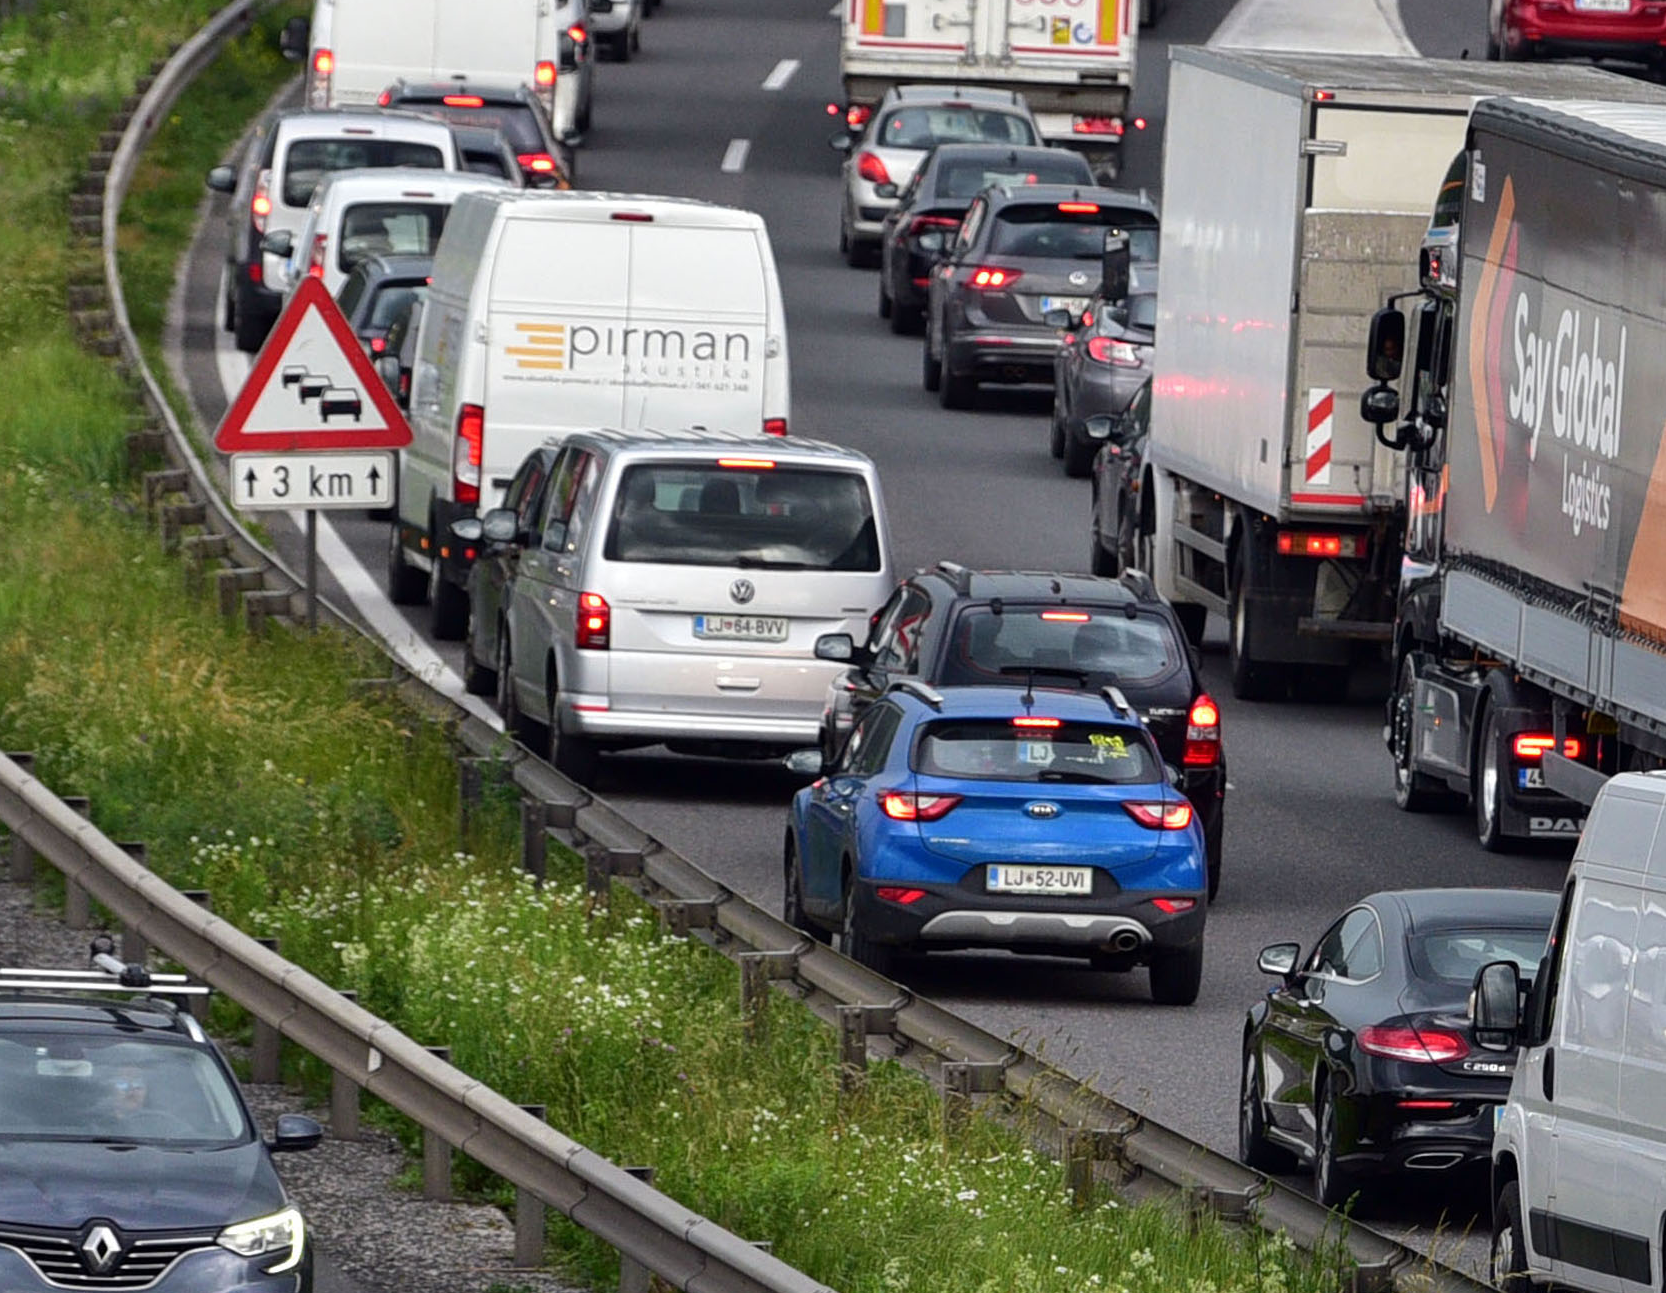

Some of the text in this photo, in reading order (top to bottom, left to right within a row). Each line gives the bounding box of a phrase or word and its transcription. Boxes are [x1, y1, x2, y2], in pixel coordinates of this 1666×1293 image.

[1510, 292, 1627, 461] Say Global
[273, 465, 352, 497] 3 km
[1561, 453, 1611, 536] Logistics
[706, 617, 723, 631] LJ
[1005, 870, 1023, 886] LJ
